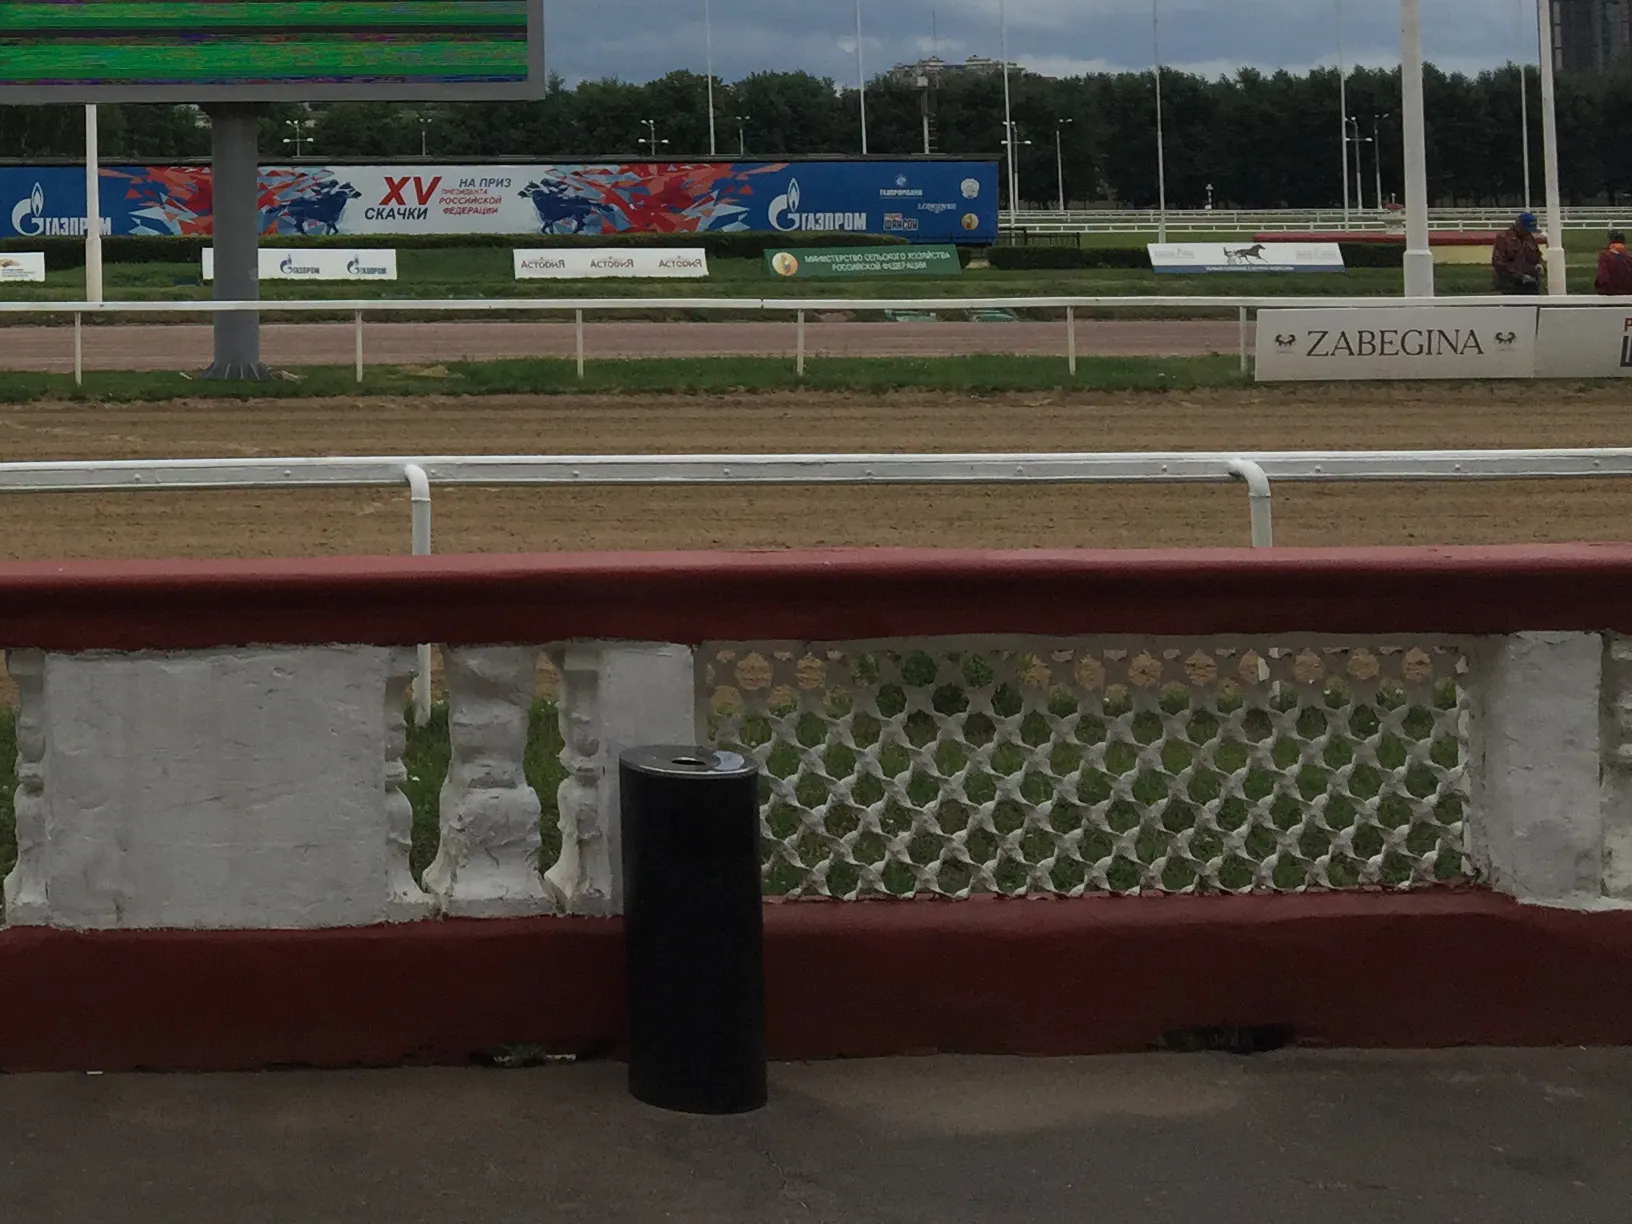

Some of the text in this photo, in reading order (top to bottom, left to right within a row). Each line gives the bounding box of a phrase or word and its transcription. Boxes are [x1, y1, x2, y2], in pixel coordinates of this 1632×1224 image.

[378, 176, 442, 206] XV
[459, 178, 512, 188] НА ПРИЗ
[438, 196, 502, 205] РОССИЙСКОЙ
[364, 207, 429, 221] СКАЧКИ
[442, 206, 499, 216] ФЕДЕРАЦИИ
[45, 217, 112, 236] ГАЗПРМ
[801, 212, 867, 231] ГАЗПРОМ
[1305, 328, 1485, 357] ZABEGINA
